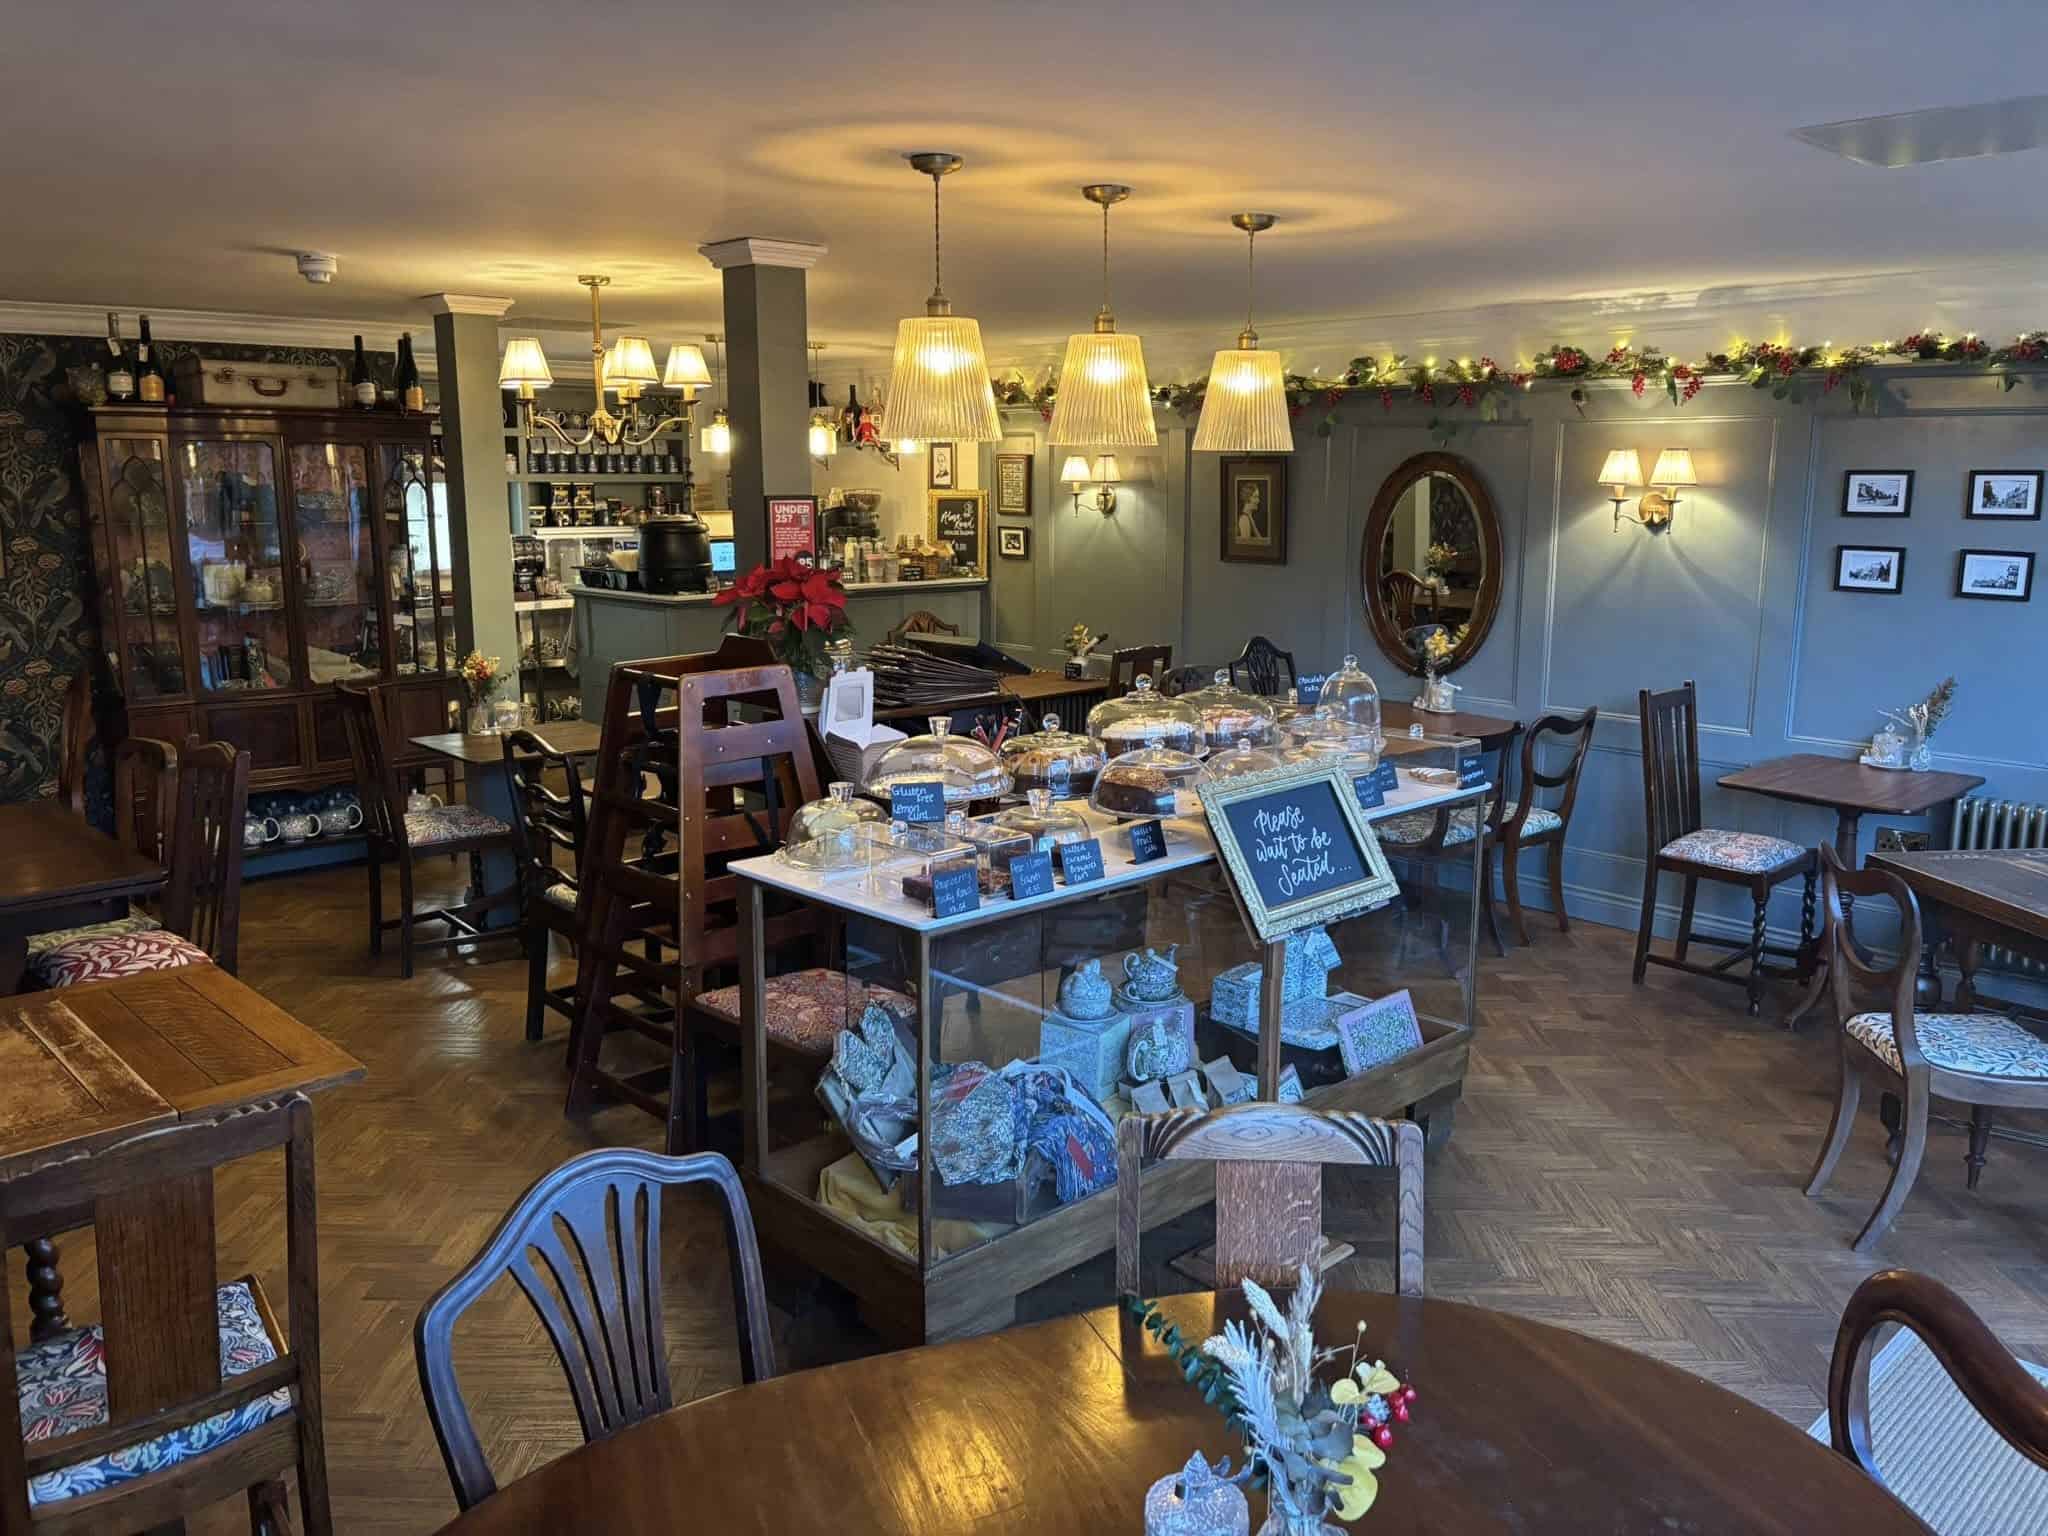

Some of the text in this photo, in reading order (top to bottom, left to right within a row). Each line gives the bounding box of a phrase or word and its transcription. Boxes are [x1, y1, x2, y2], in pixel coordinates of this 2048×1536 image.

[775, 504, 810, 514] UNDER
[775, 514, 793, 524] 25?
[1254, 805, 1304, 836] Please
[1288, 832, 1309, 854] to
[1310, 827, 1332, 849] be
